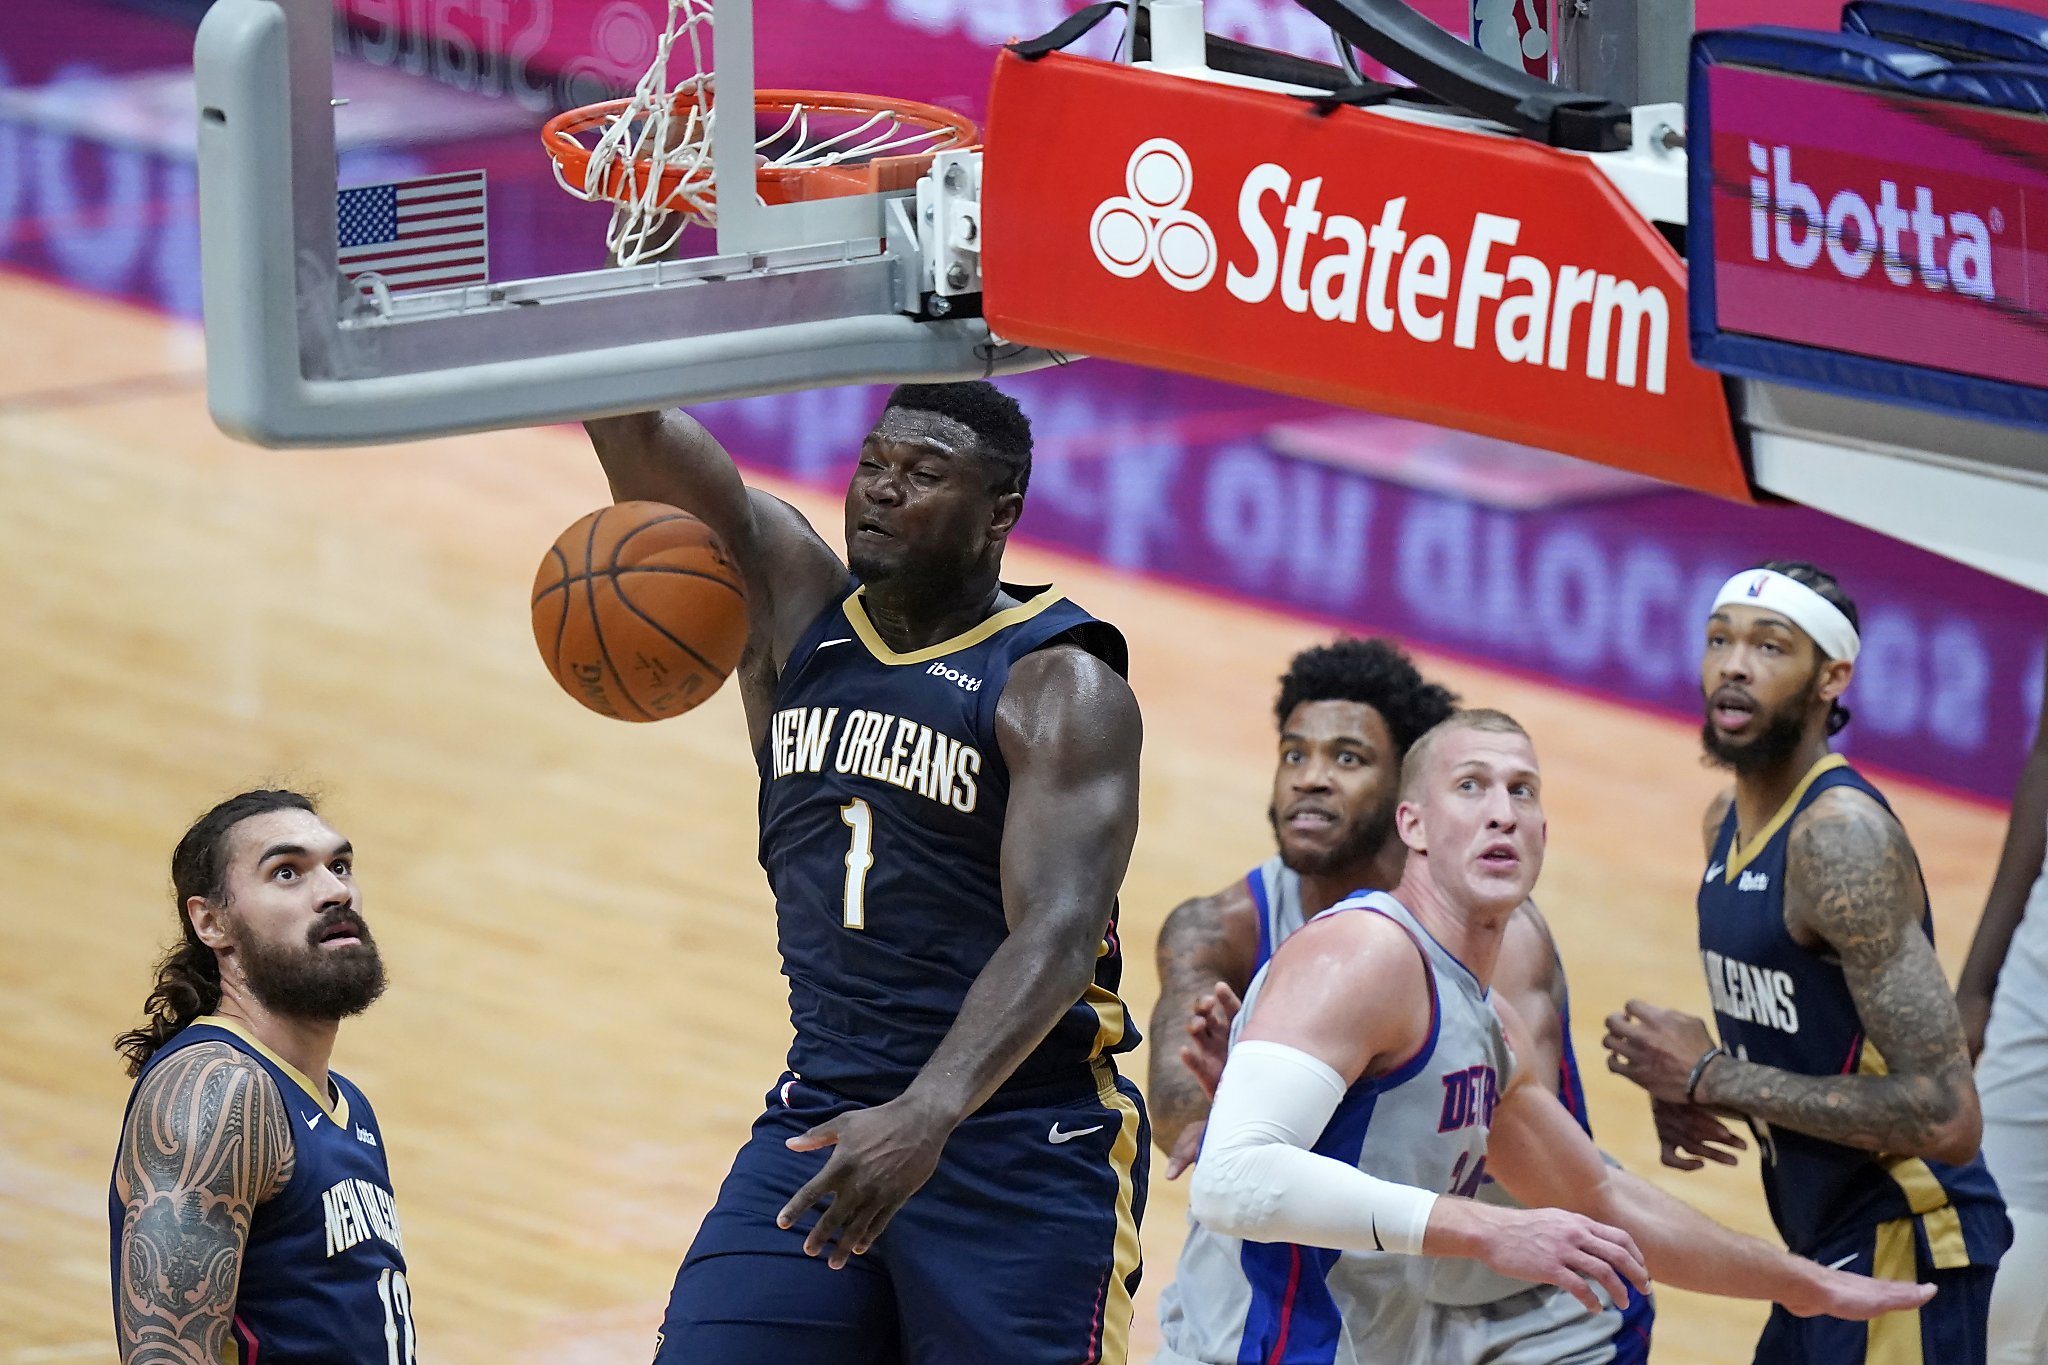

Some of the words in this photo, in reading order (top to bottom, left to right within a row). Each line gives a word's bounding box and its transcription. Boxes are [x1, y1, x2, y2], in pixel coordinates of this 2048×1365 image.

[1749, 140, 1996, 301] ibotta
[772, 706, 839, 781] NEW
[835, 708, 982, 814] ORLEANS
[840, 797, 874, 930] 1
[322, 1178, 372, 1258] NEW
